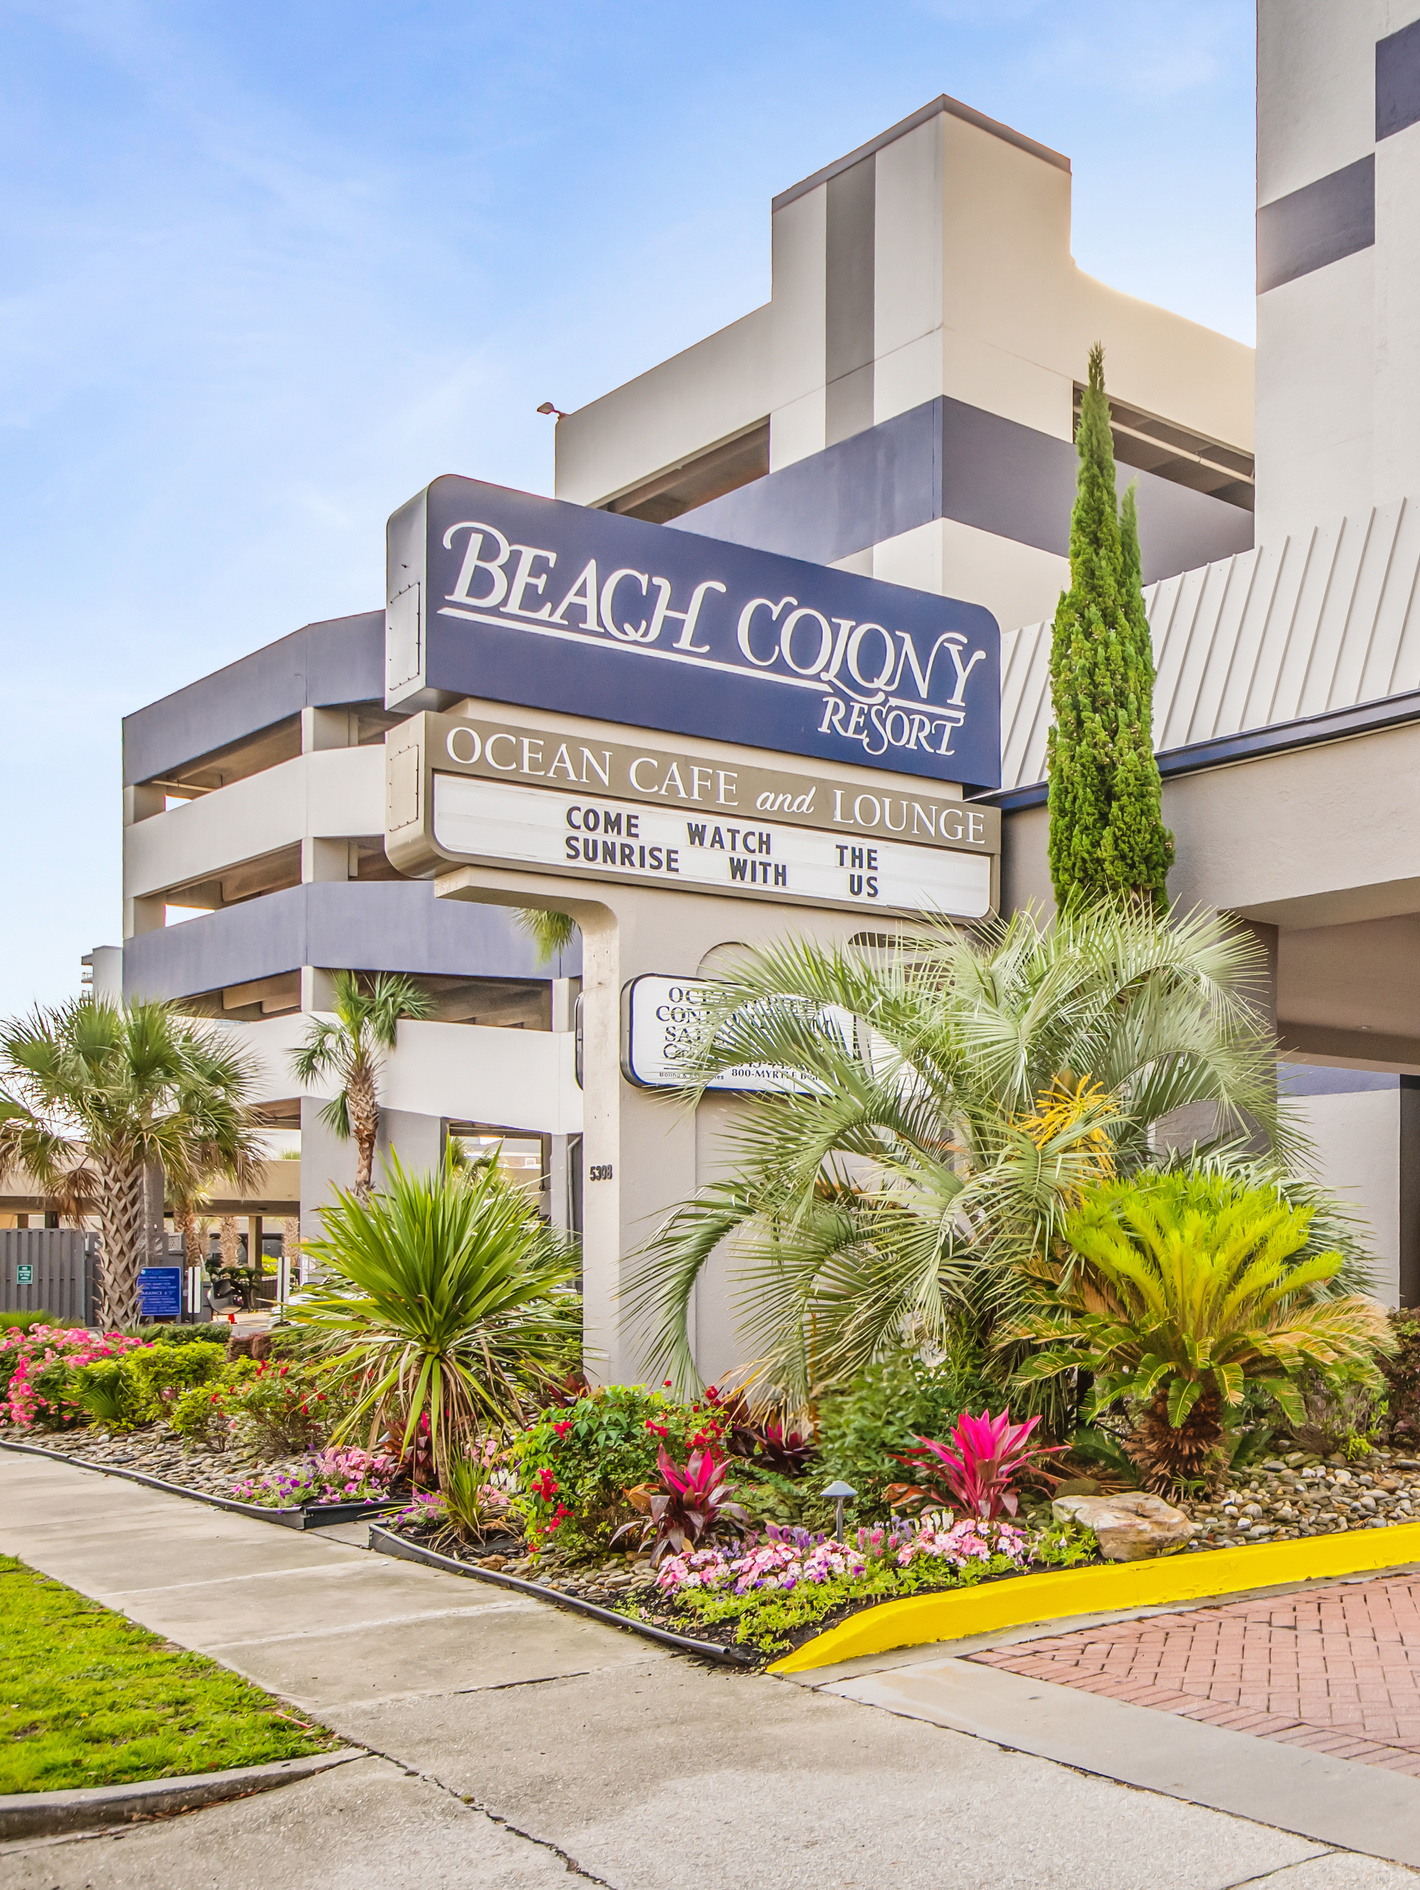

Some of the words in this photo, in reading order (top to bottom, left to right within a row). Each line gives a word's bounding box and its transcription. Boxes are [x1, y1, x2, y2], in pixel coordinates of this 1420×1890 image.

[442, 520, 727, 653] BEACH
[736, 596, 987, 706] COLONY
[818, 696, 965, 756] RESORT
[446, 726, 613, 788] OCEAN
[629, 757, 739, 806] CAFE
[756, 786, 815, 815] and
[833, 789, 986, 846] LOUNGE
[565, 836, 680, 873] SUNRISE
[729, 856, 788, 887] WITH
[848, 874, 879, 898] US
[566, 806, 641, 839] COME
[687, 822, 772, 856] WATCH
[836, 844, 879, 871] THE
